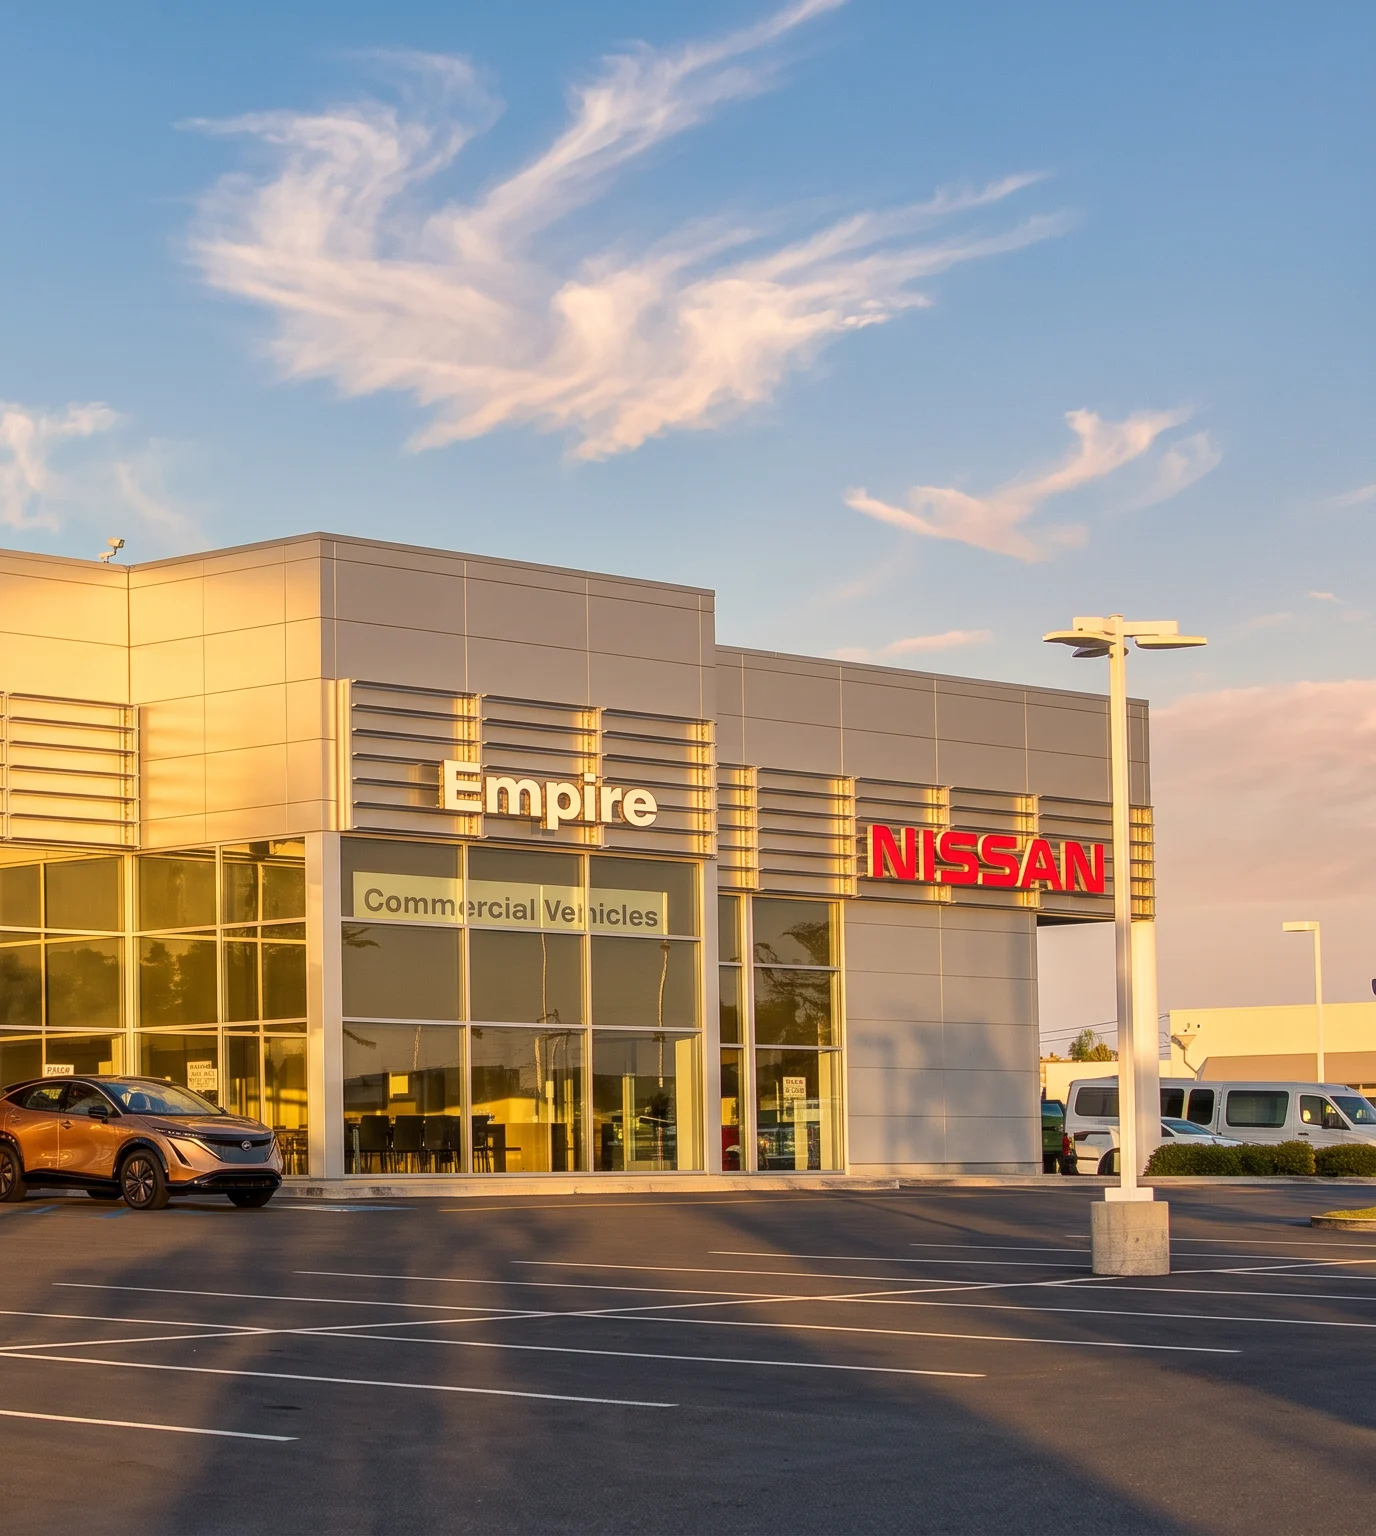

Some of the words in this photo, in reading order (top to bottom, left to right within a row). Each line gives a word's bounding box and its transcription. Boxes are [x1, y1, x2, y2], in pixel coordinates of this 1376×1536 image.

[440, 759, 658, 831] Empire
[869, 824, 1105, 894] NISSAN
[363, 888, 536, 921] Commercial
[543, 898, 659, 928] Vehicles
